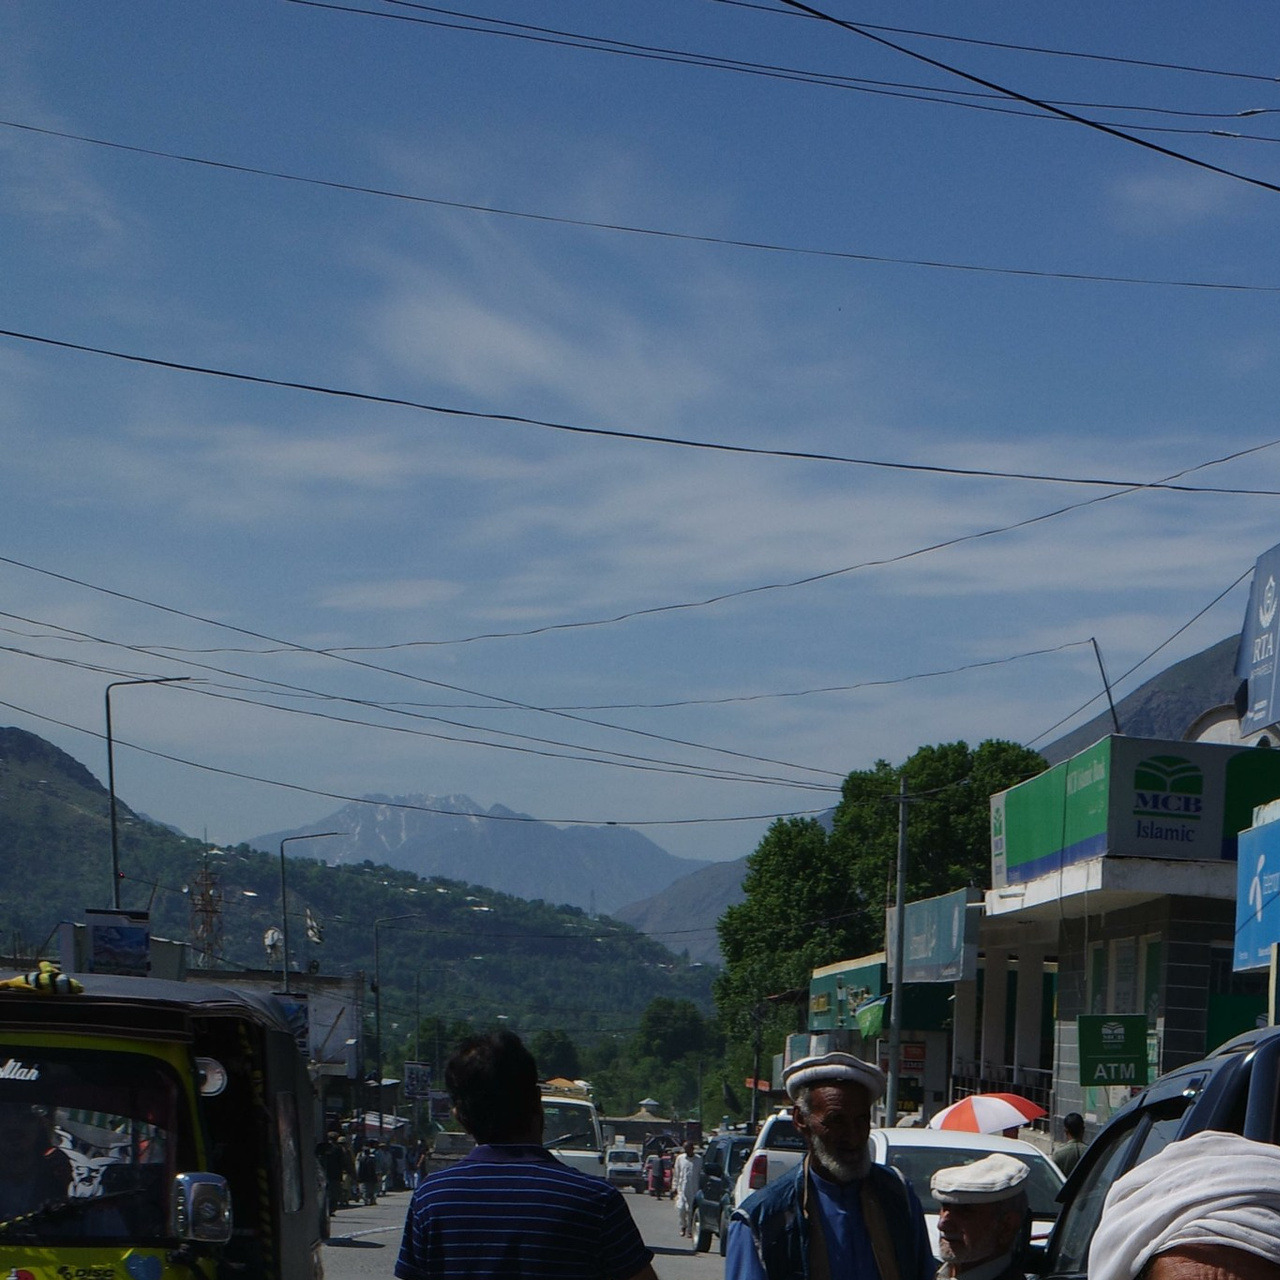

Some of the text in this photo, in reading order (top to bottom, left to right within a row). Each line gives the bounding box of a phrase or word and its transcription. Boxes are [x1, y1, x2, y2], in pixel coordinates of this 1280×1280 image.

[1135, 792, 1202, 813] MCB
[1137, 820, 1194, 842] Islamic
[1093, 1062, 1136, 1080] ATM
[75, 1268, 115, 1278] DISC
